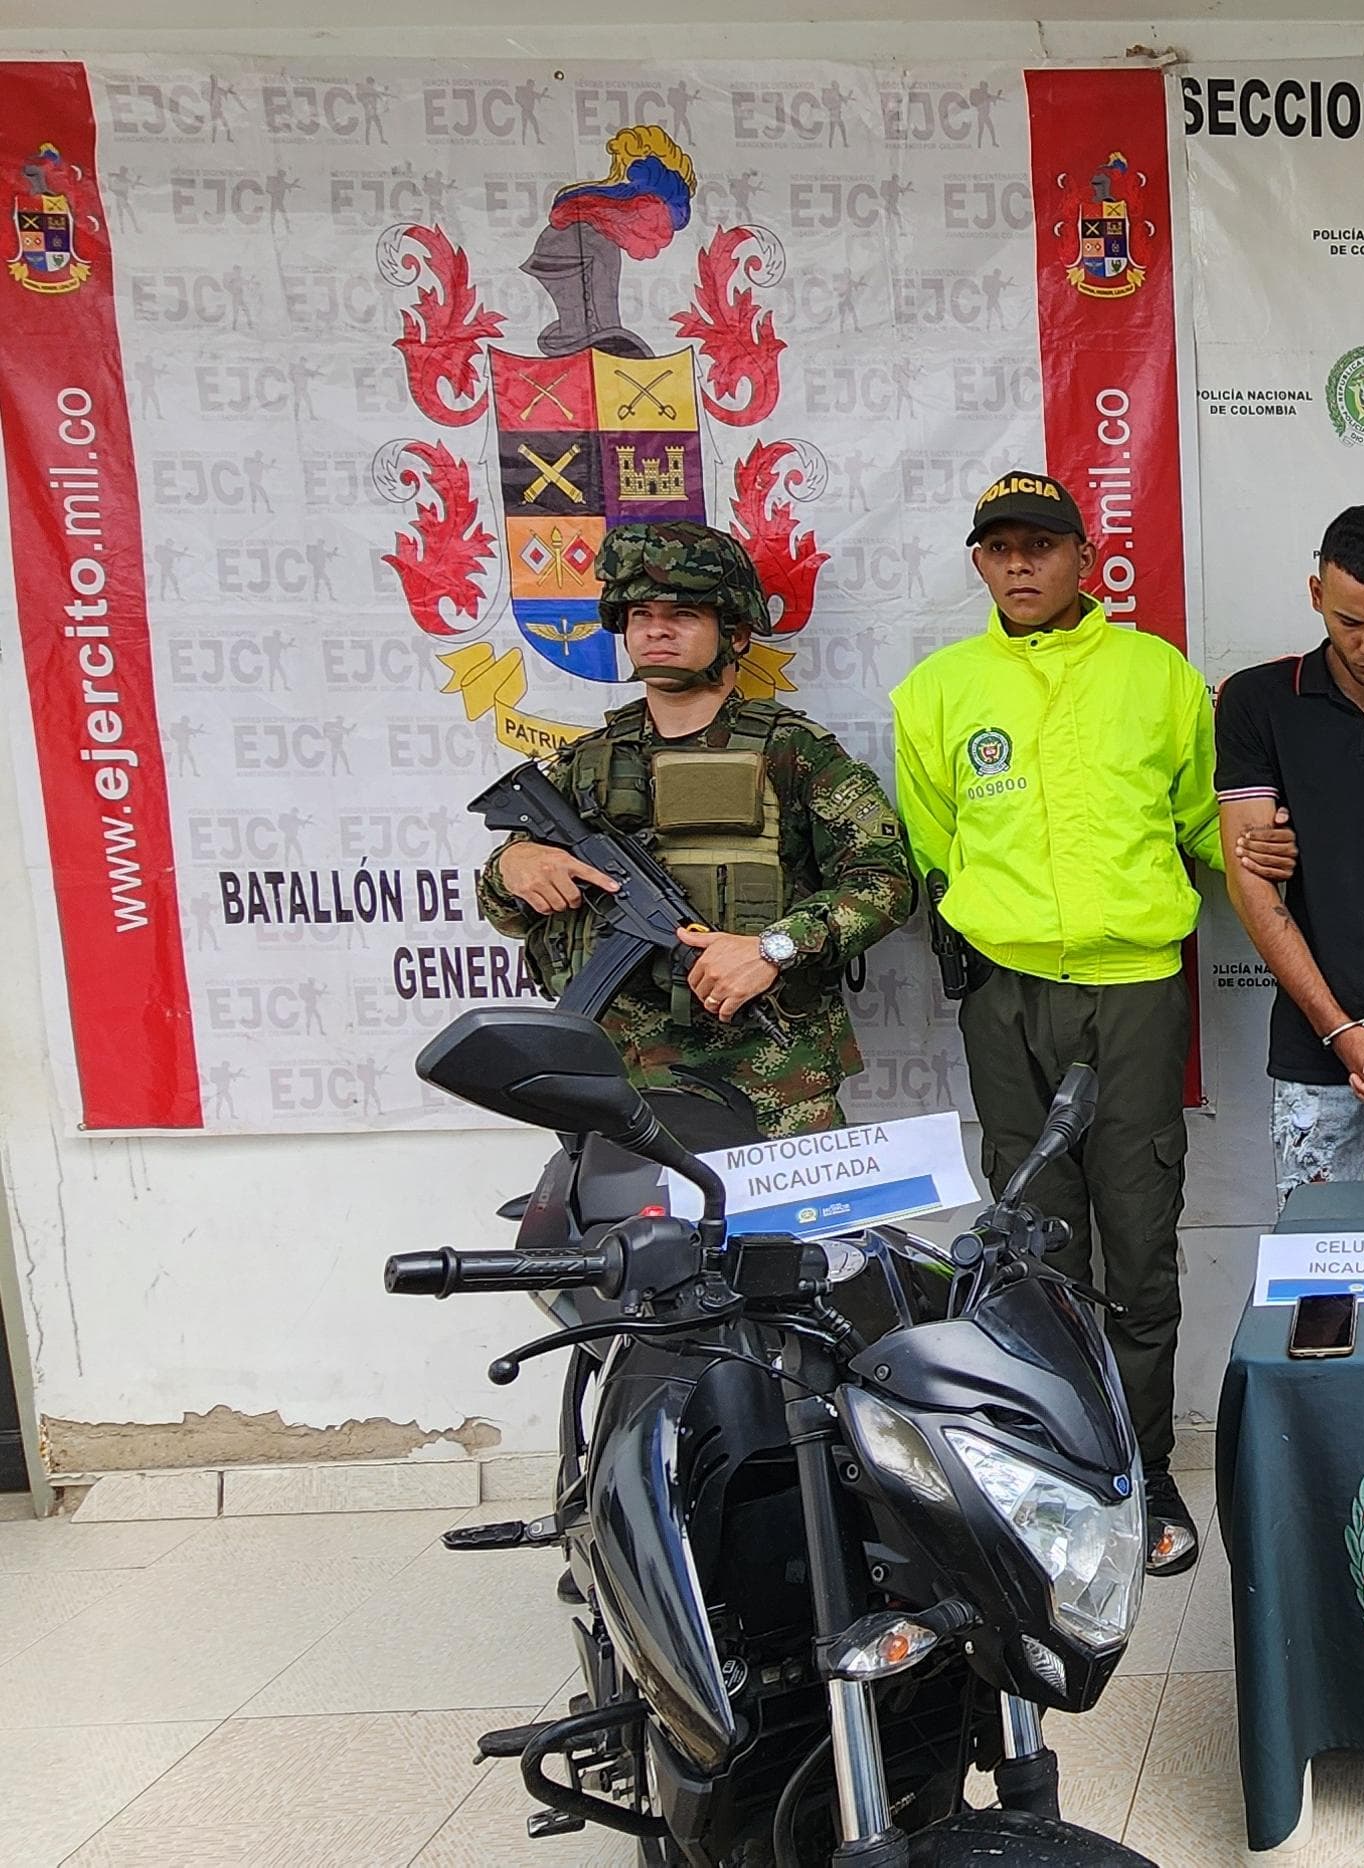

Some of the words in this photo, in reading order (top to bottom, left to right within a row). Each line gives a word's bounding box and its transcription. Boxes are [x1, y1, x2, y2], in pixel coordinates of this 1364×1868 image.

[484, 182, 556, 228] EJ
[1313, 228, 1364, 241] POLICÍA
[1330, 245, 1347, 255] DE
[1210, 406, 1226, 415] DE
[1231, 406, 1297, 415] COLOMBIA
[1248, 391, 1313, 401] NACIONAL
[49, 387, 149, 932] www.ejercito.mil.co
[968, 777, 1027, 800] 009800
[219, 856, 403, 925] BATALLÓN
[416, 869, 463, 922] DE
[394, 946, 539, 1000] GENERA
[1218, 978, 1234, 987] DE
[727, 1126, 888, 1170] MOTOCICLETA
[748, 1156, 880, 1196] INCAUTADA
